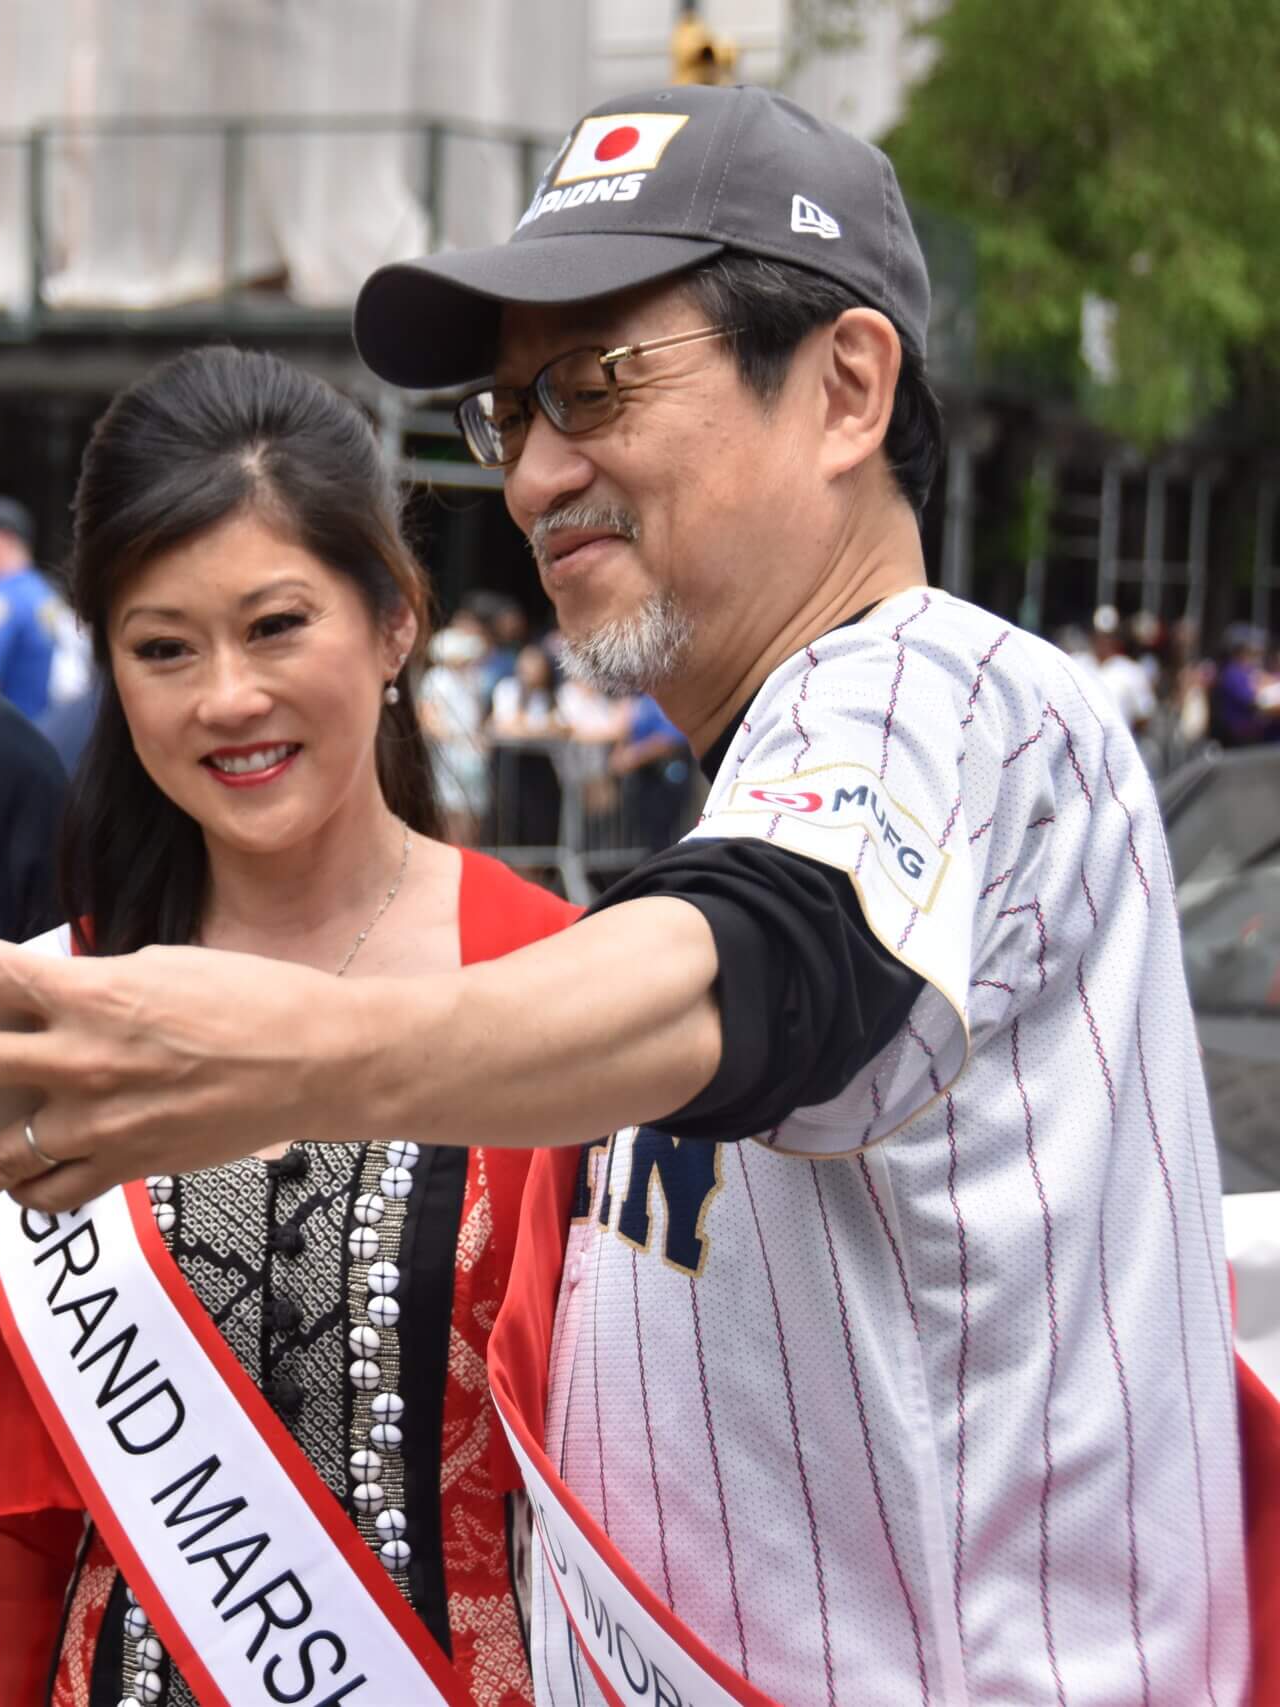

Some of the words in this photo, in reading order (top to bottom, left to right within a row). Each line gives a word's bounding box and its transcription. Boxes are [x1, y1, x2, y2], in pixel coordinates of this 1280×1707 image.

[832, 785, 926, 880] MUFG
[20, 1207, 186, 1455] GRAND
[575, 1559, 694, 1707] MOR
